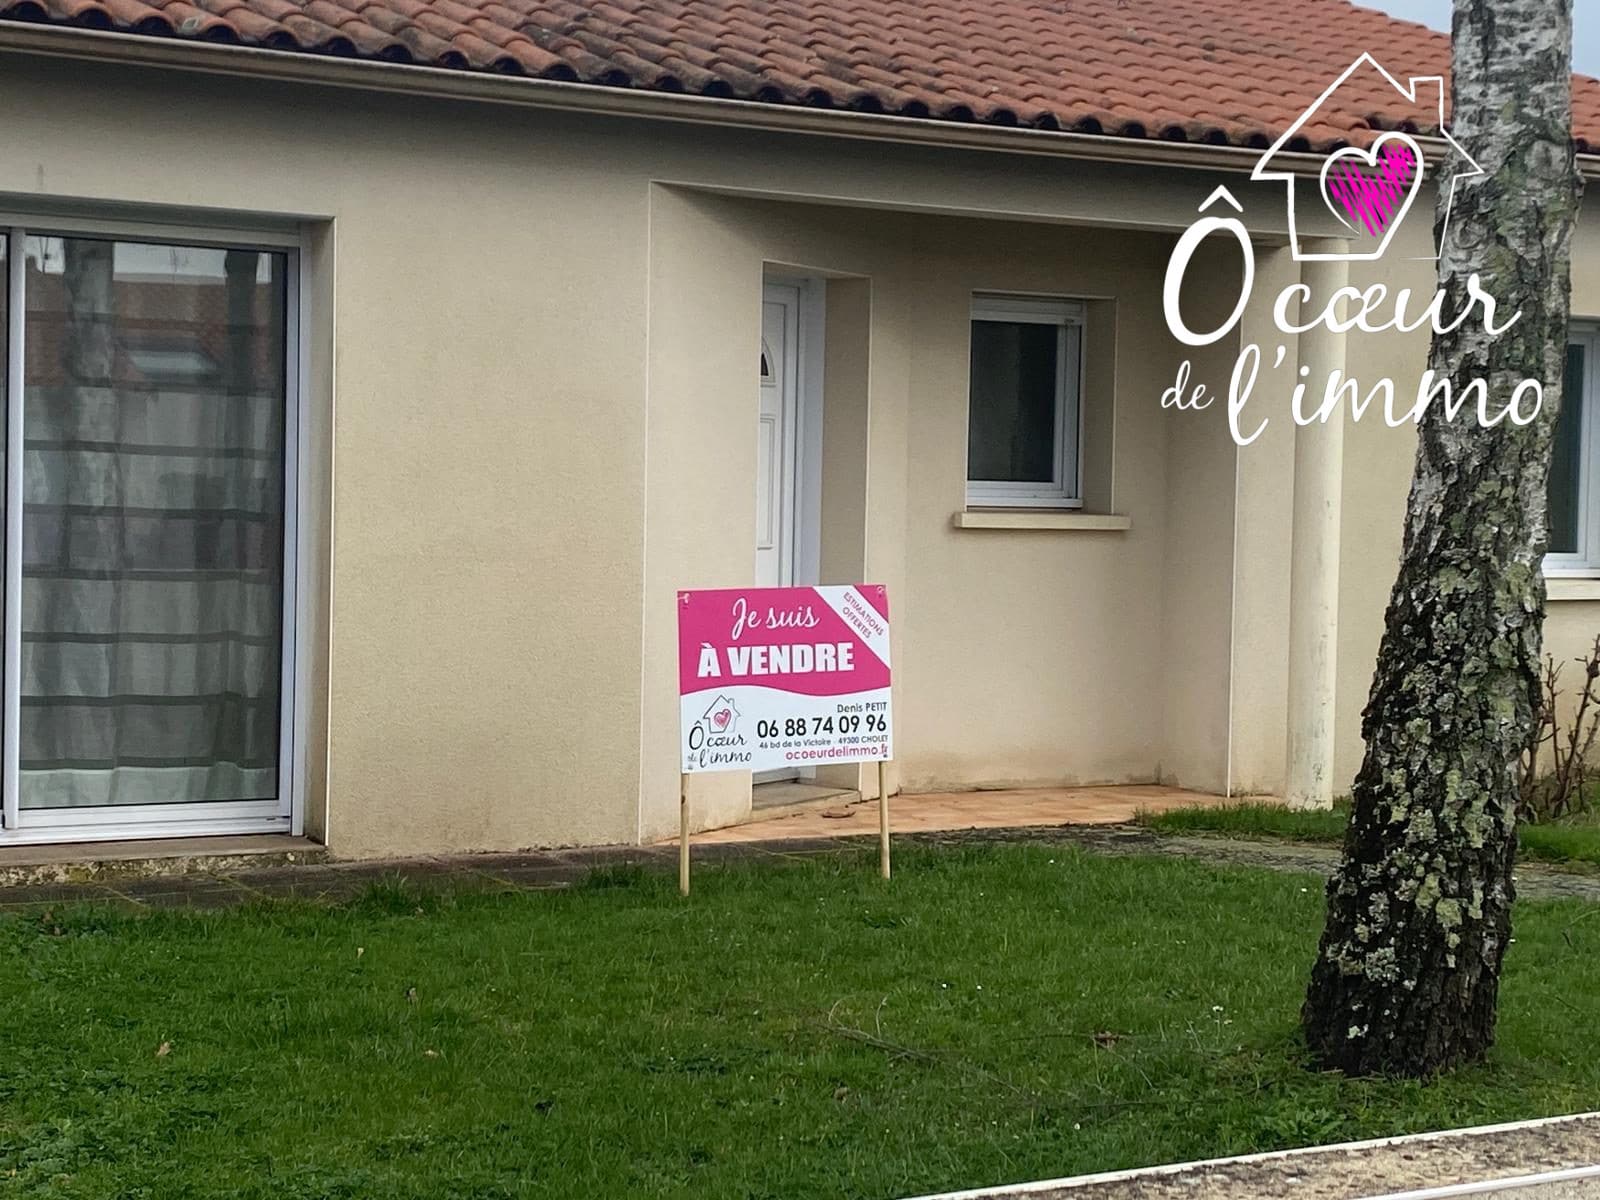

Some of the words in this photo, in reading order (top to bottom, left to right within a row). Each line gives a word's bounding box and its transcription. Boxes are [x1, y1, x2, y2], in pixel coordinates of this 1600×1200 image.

[731, 597, 761, 640] Je
[766, 606, 820, 630] suis
[842, 606, 872, 639] OFFERTES
[843, 591, 884, 636] ESTIMATIONS
[697, 642, 722, 678] À
[727, 642, 855, 676] VENDRE
[837, 703, 863, 713] Denis
[865, 702, 887, 712] PETIT
[757, 719, 779, 738] 06
[785, 718, 807, 737] 88
[812, 716, 834, 735] 74
[838, 715, 860, 734] 09
[866, 714, 887, 732] 96
[770, 740, 781, 748] bd
[782, 740, 793, 748] de
[794, 739, 802, 747] la
[803, 738, 831, 747] Victoire
[838, 736, 860, 744] 49300
[861, 735, 888, 743] CHOLET
